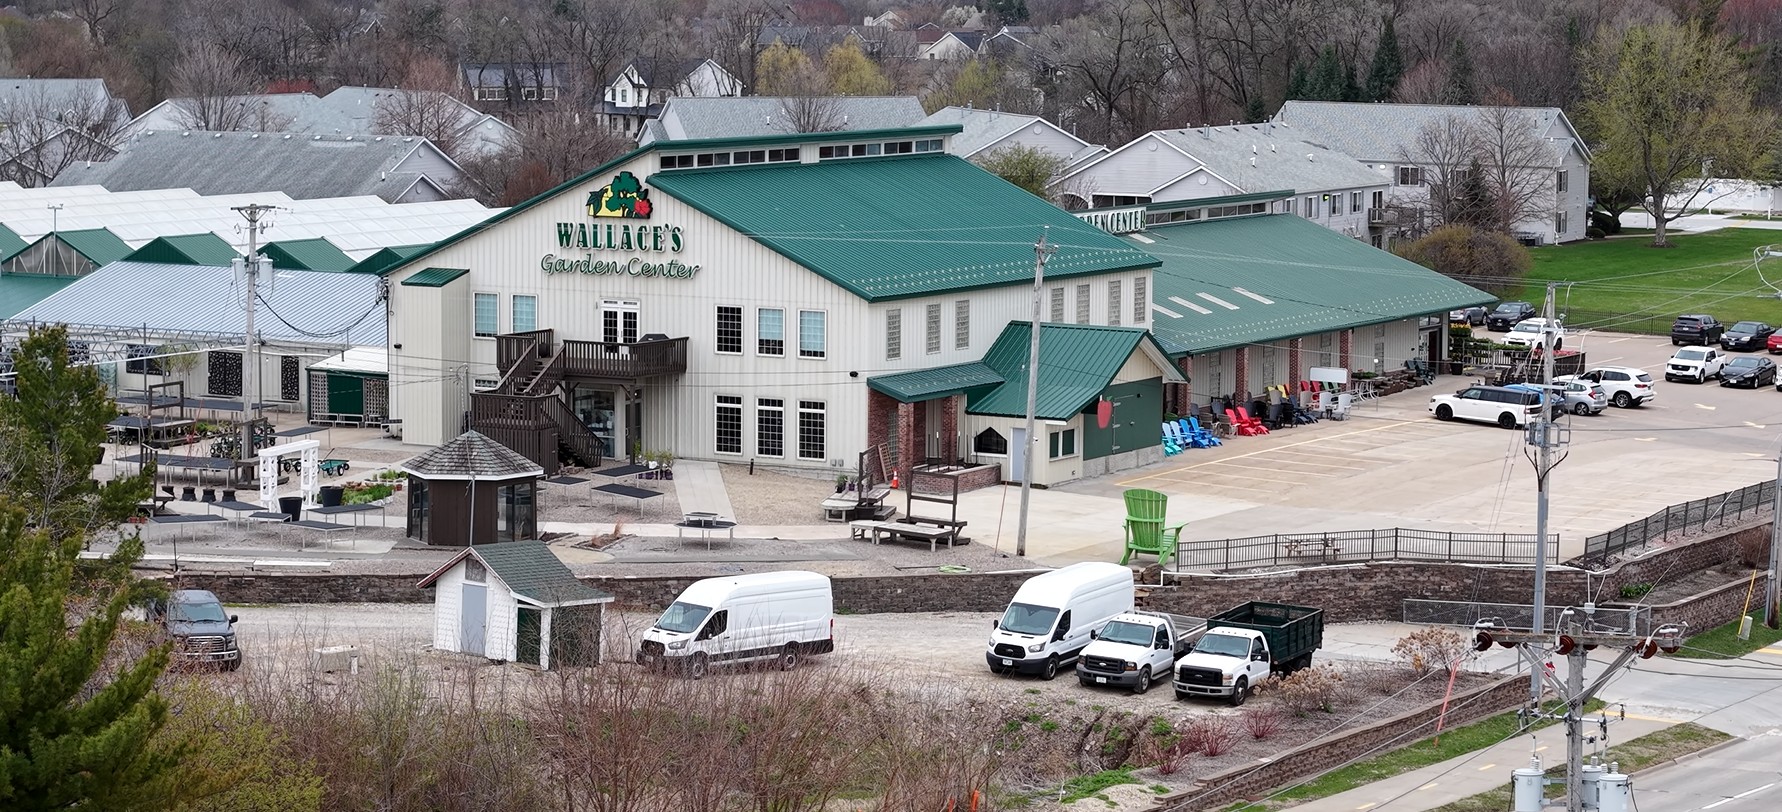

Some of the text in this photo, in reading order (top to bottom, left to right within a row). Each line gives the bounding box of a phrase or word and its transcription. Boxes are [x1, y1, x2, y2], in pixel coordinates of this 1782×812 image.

[1109, 210, 1147, 233] CENTER
[556, 222, 684, 252] WALLACE'S
[541, 253, 701, 279] Garden Center
